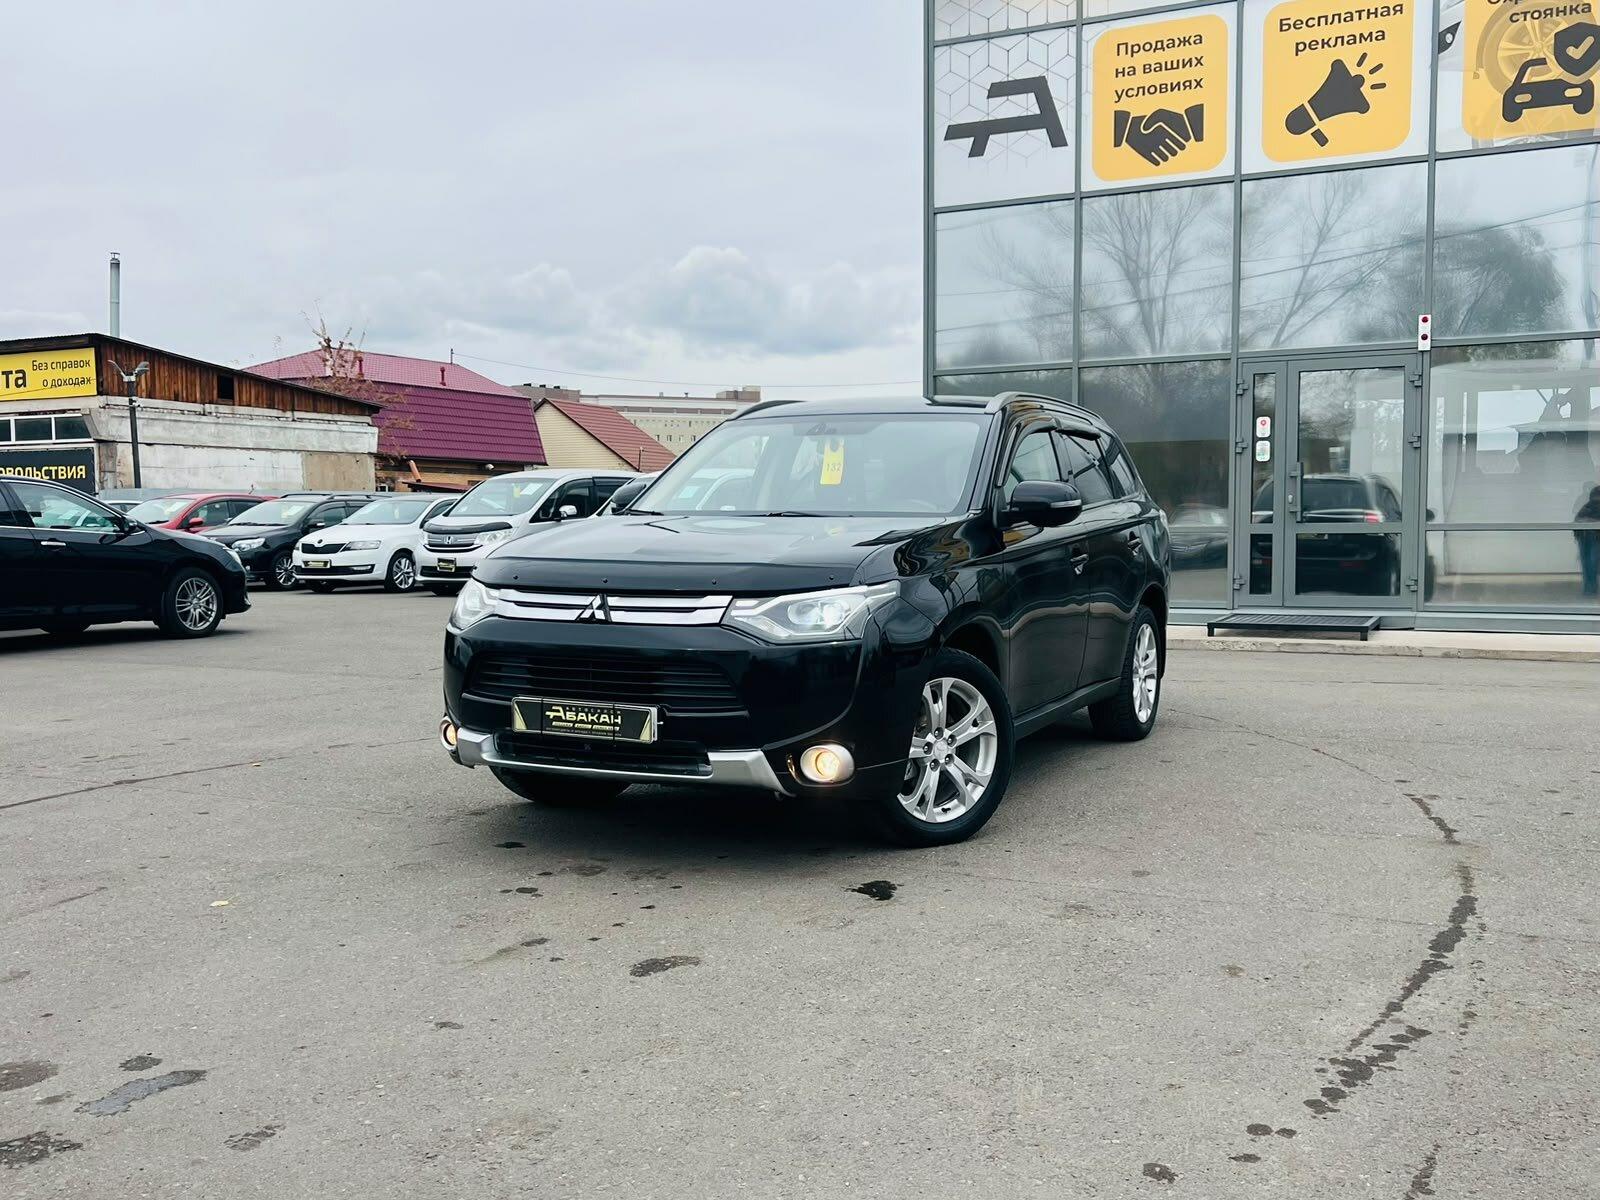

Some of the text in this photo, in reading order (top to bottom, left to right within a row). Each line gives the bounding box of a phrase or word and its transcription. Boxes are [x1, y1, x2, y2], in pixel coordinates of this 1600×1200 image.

[1279, 3, 1403, 32] Бесплатная
[1509, 2, 1592, 23] стоянка
[1116, 33, 1203, 58] Продажа
[1295, 29, 1386, 56] реклама
[1115, 55, 1204, 78] на ваших
[1114, 77, 1204, 104] условиях
[32, 359, 91, 371] Без справок
[1, 369, 27, 389] та
[42, 376, 92, 389] о доходах
[545, 706, 621, 724] АБАКАН
